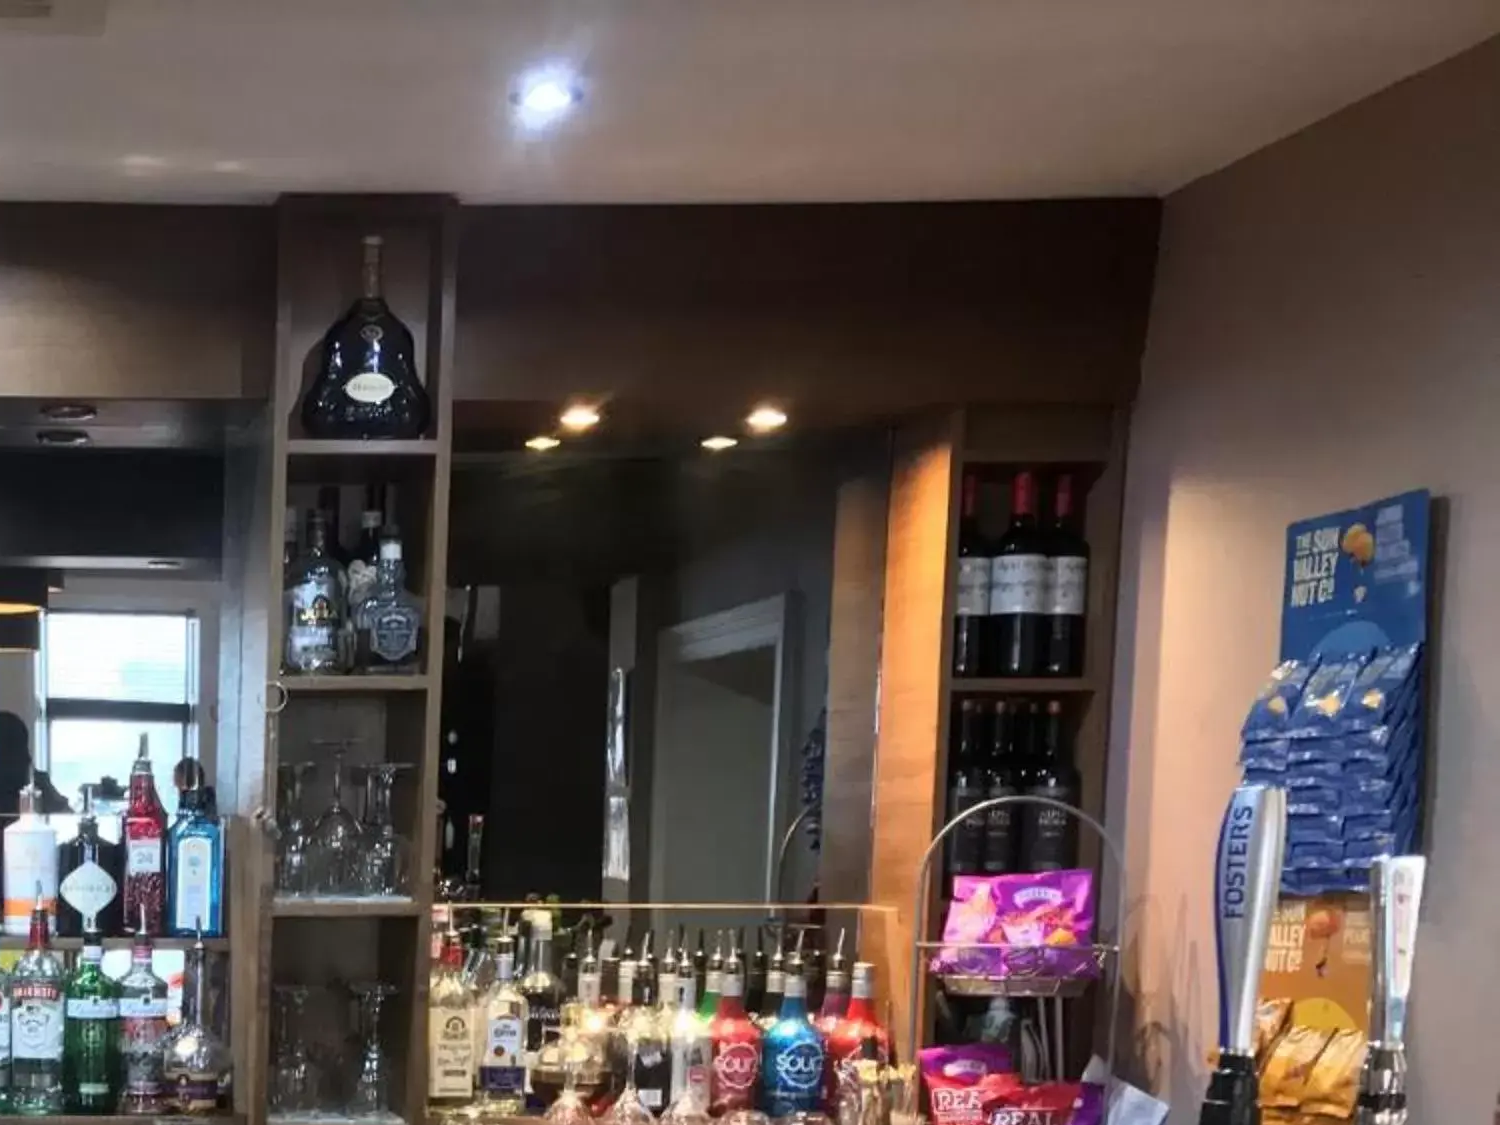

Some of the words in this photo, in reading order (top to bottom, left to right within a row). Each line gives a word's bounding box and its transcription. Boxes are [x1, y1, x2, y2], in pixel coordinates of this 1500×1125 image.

[1293, 551, 1339, 580] VALLEY
[1290, 581, 1317, 608] NUT
[1223, 805, 1254, 919] FOSTERS
[1269, 923, 1306, 949] ALLEY
[936, 1089, 980, 1111] REA
